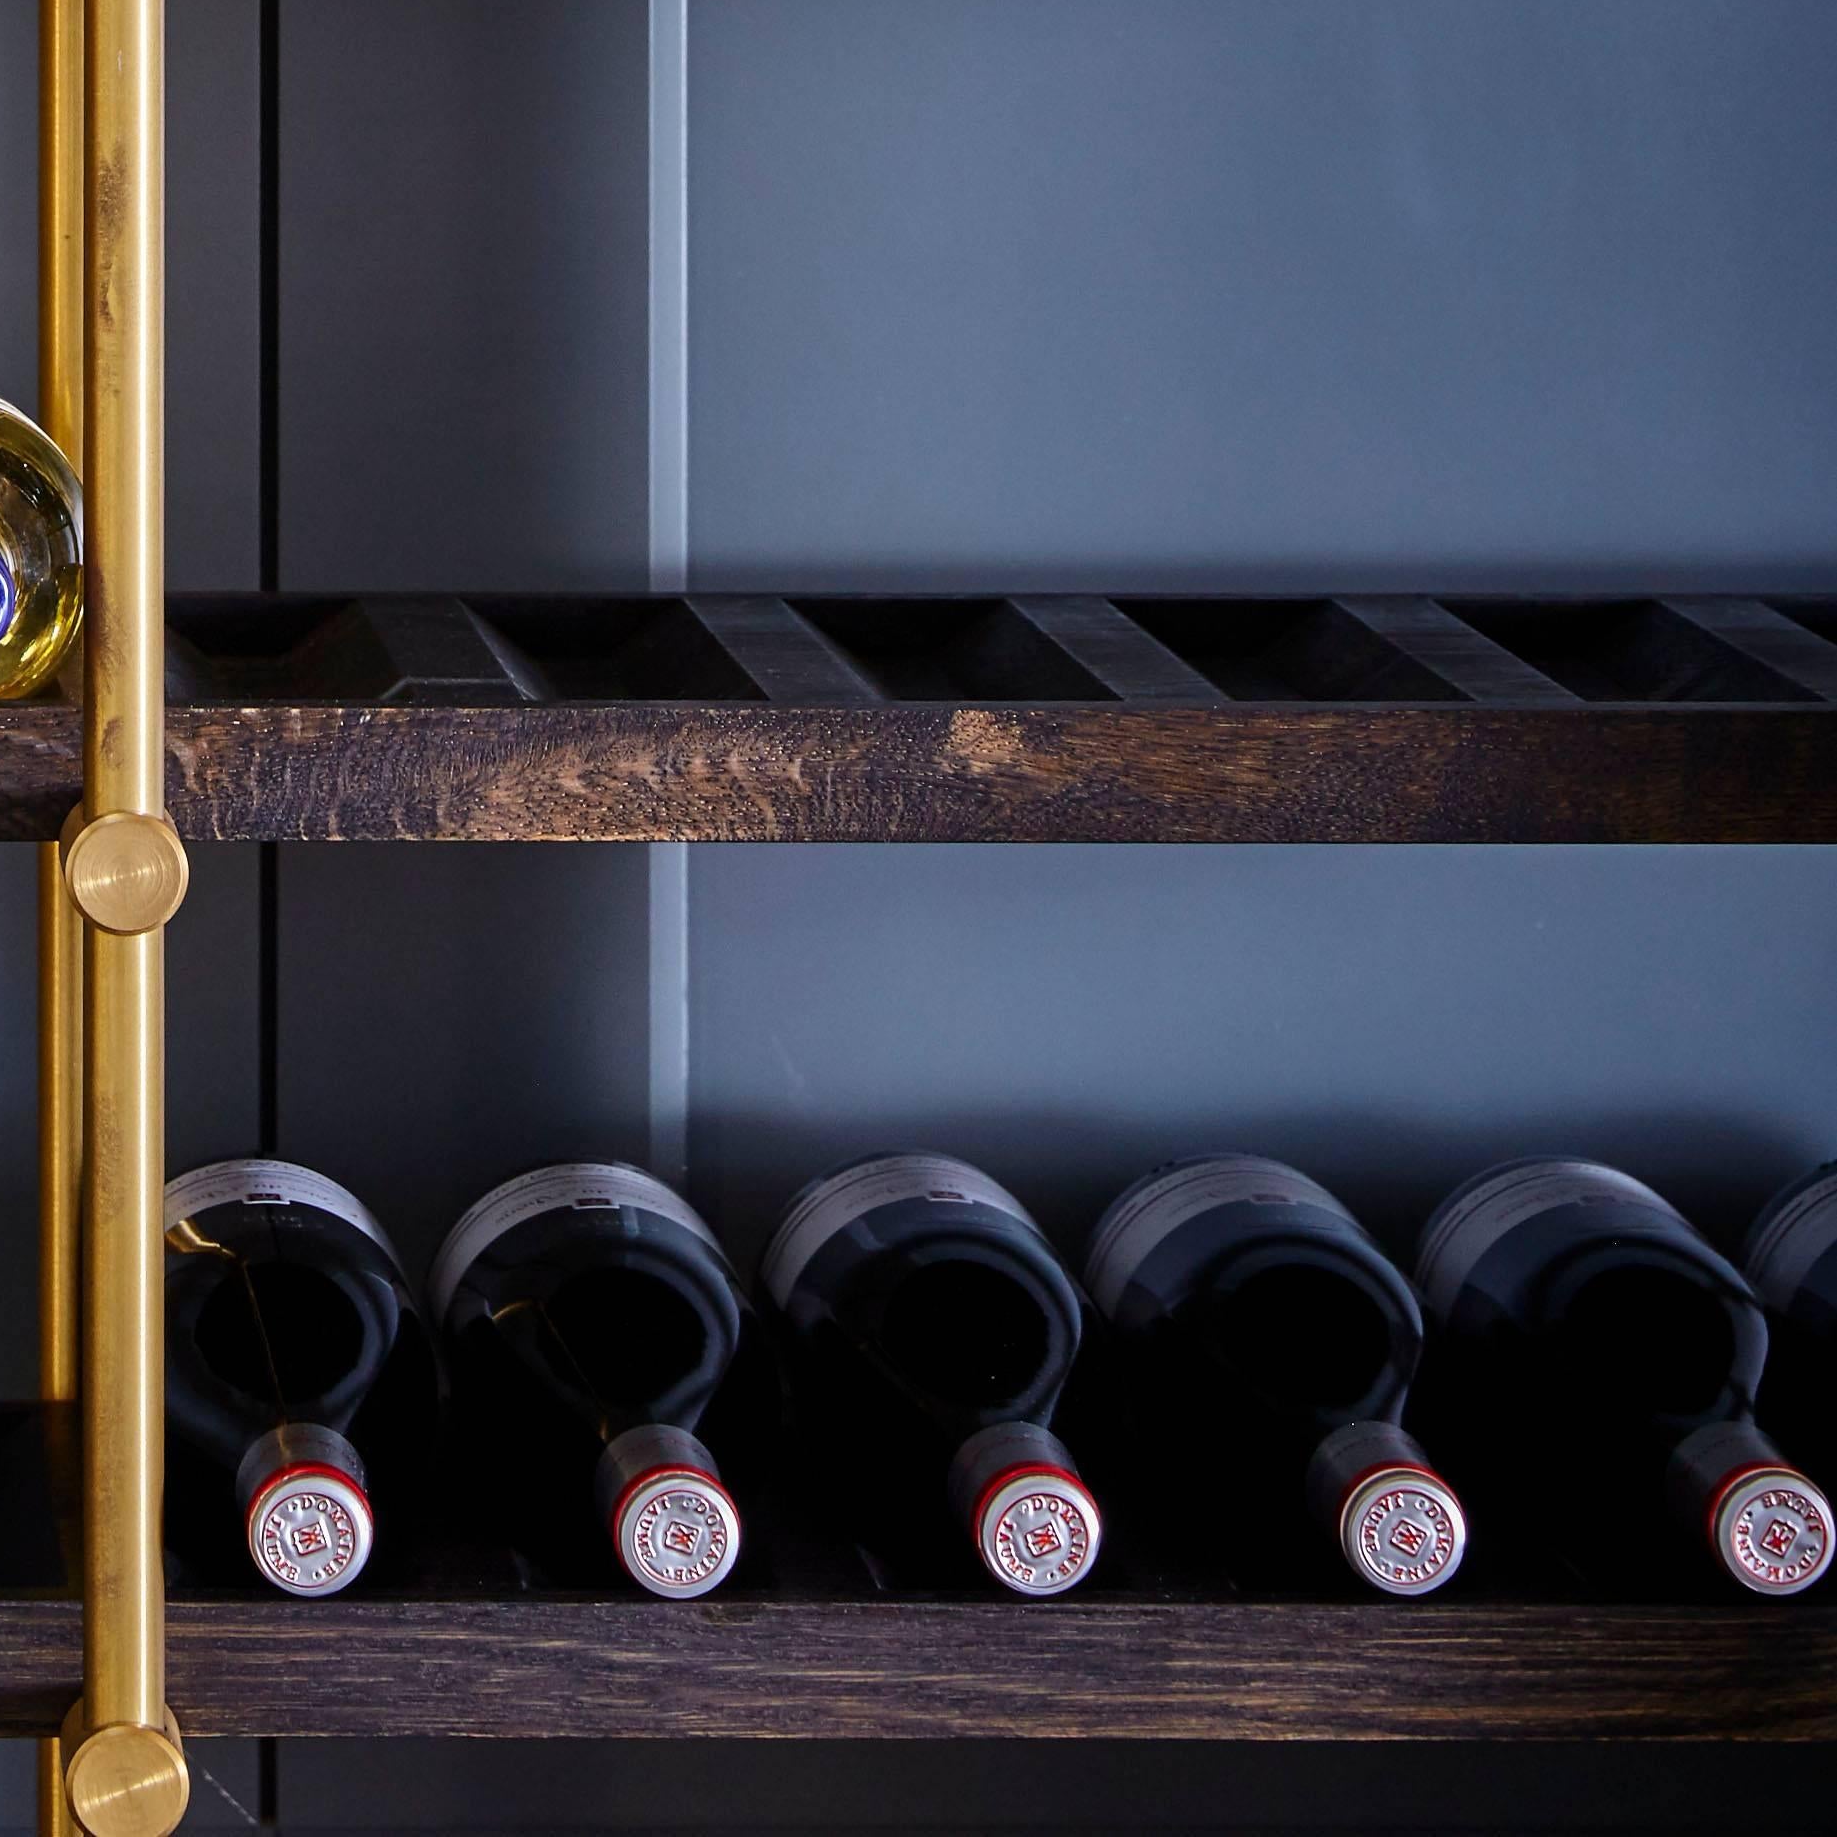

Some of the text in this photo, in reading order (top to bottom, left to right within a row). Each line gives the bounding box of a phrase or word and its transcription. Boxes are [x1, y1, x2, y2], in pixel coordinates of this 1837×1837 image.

[301, 1494, 355, 1578] DOMAINE
[674, 1499, 727, 1582] DOMAINE
[1031, 1496, 1089, 1578] DOMAINE
[1392, 1505, 1454, 1581] DOMAINE
[1736, 1522, 1814, 1582] DOMAINE
